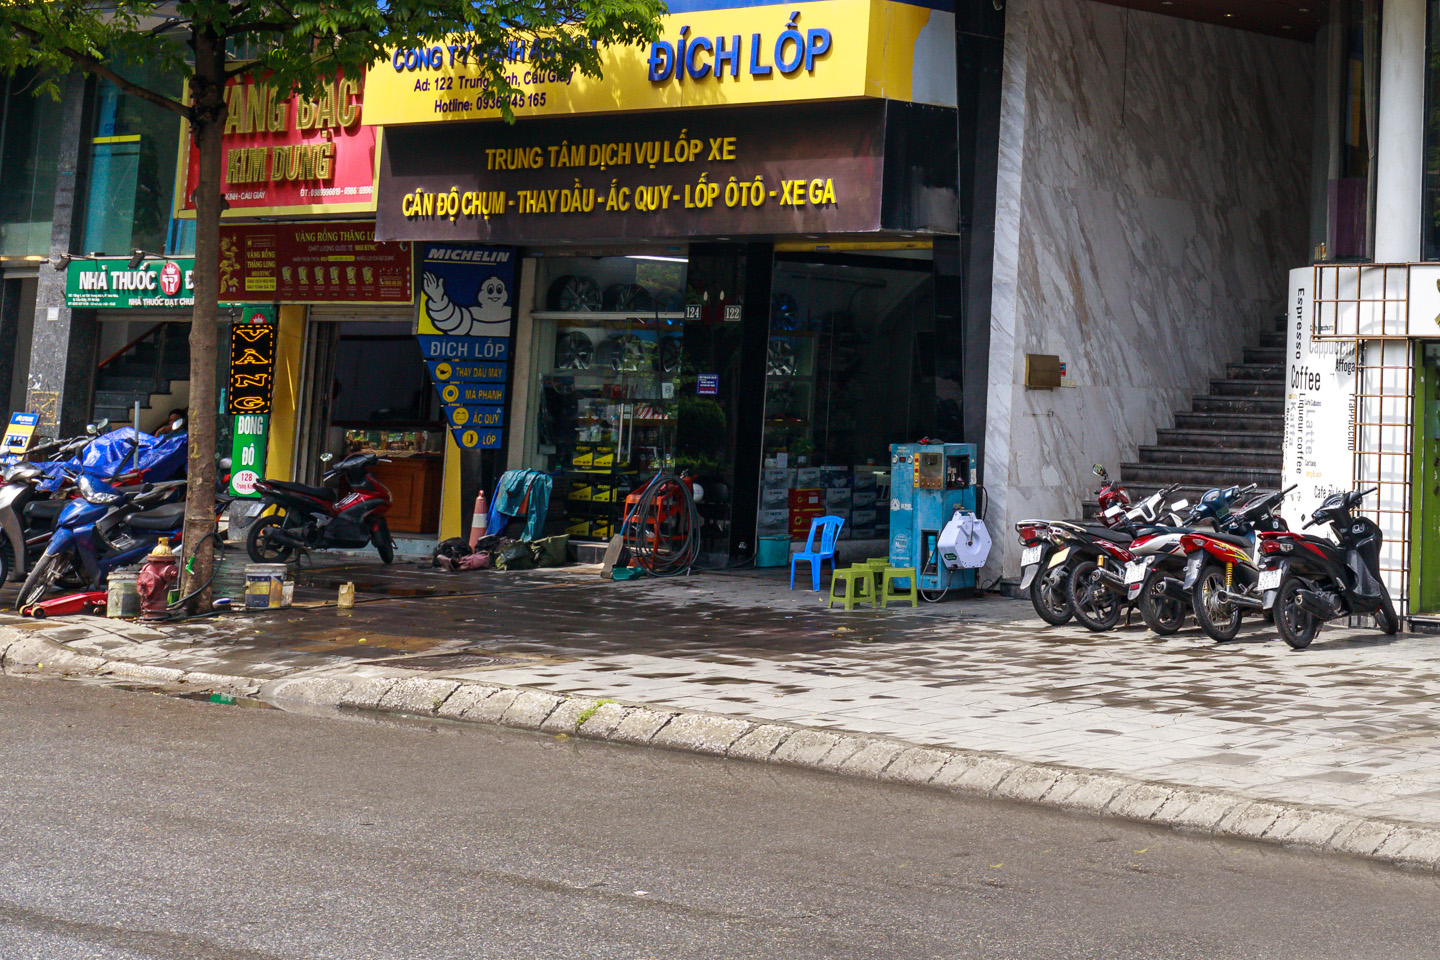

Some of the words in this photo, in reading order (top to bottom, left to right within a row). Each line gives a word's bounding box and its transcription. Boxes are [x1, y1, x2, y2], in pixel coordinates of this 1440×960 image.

[647, 25, 741, 82] ĐÍCH
[750, 11, 832, 74] LỐP
[414, 78, 430, 92] Ad:
[434, 77, 453, 90] 122
[458, 75, 490, 95] Trung
[434, 99, 473, 113] Hotline:
[528, 92, 547, 107] 165
[486, 146, 544, 170] TRUNG
[548, 140, 586, 168] TÂM
[589, 142, 631, 170] DỊCH
[635, 141, 661, 169] VỤ
[663, 128, 703, 163] LỐP
[708, 137, 736, 161] XE
[226, 147, 269, 183] KIM
[271, 142, 334, 181] DUNG
[402, 187, 436, 216] CÂN
[437, 186, 460, 221] ĐỘ
[462, 191, 506, 220] CHỤM
[517, 189, 560, 214] THAY
[560, 178, 595, 213] DẦU
[606, 178, 631, 212] ẮC
[635, 184, 673, 212] QUY
[685, 172, 720, 208] LỐP
[725, 175, 766, 207] ÔTÔ
[779, 179, 807, 206] XE
[808, 178, 837, 205] GA
[295, 230, 316, 242] VÀNG
[428, 248, 510, 263] MICHELIN
[79, 265, 108, 290] NHÀ
[110, 262, 157, 290] THUỐC
[128, 296, 142, 305] NHÀ
[686, 306, 700, 319] 124
[725, 307, 740, 319] 122
[1295, 288, 1305, 360] Espresso
[430, 339, 468, 357] ĐÍCH
[475, 338, 505, 358] LỐP
[456, 366, 472, 377] THAY
[488, 363, 503, 378] MÁY
[1291, 364, 1321, 391] Coffee
[478, 389, 502, 400] PHANH
[472, 411, 483, 424] ẮC
[483, 413, 500, 426] QUY
[482, 430, 496, 445] LỐP
[1305, 409, 1316, 455] Latte
[242, 442, 255, 465] ĐÔ
[1295, 436, 1304, 474] coffee
[241, 473, 253, 482] 128
[1314, 485, 1327, 499] Cafe
